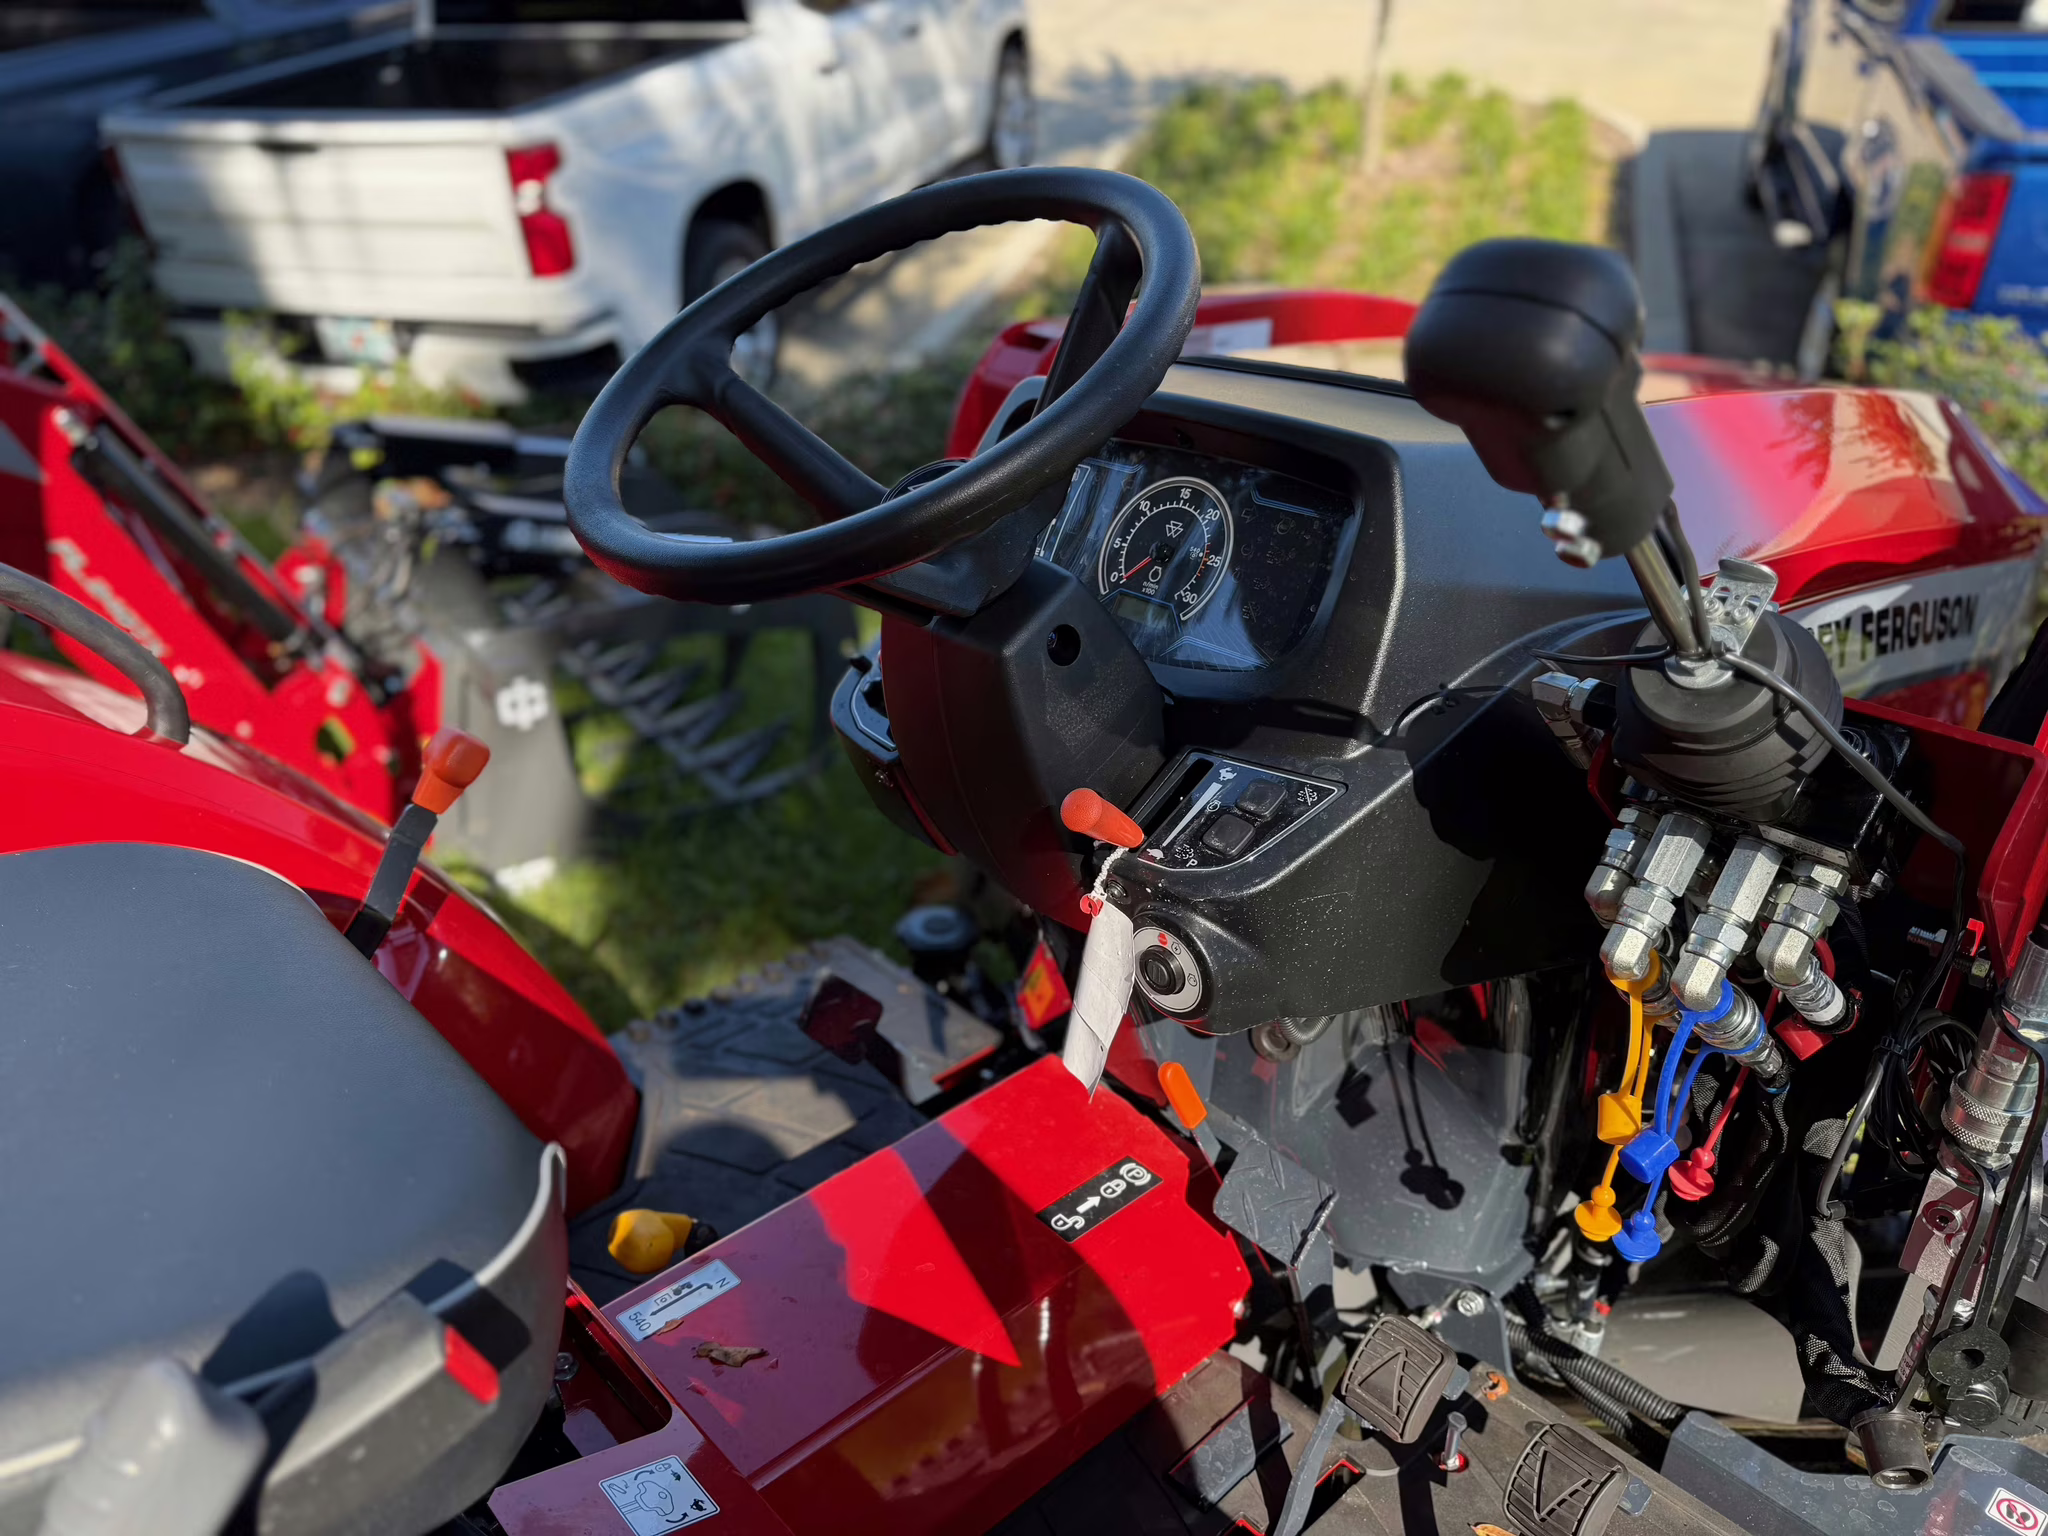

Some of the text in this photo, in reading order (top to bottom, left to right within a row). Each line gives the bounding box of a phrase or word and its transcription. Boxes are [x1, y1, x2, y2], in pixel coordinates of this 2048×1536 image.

[1180, 487, 1192, 499] 15
[1139, 500, 1151, 512] 10
[1205, 508, 1220, 521] 20
[1113, 538, 1122, 548] 5
[1207, 554, 1222, 567] 25
[1110, 571, 1118, 582] 0
[1141, 587, 1156, 596] x100
[1142, 581, 1159, 590] n/min
[1182, 591, 1198, 604] 30
[1807, 594, 1978, 668] EY FERGUSON
[1186, 859, 1198, 867] P
[628, 1311, 652, 1332] 540
